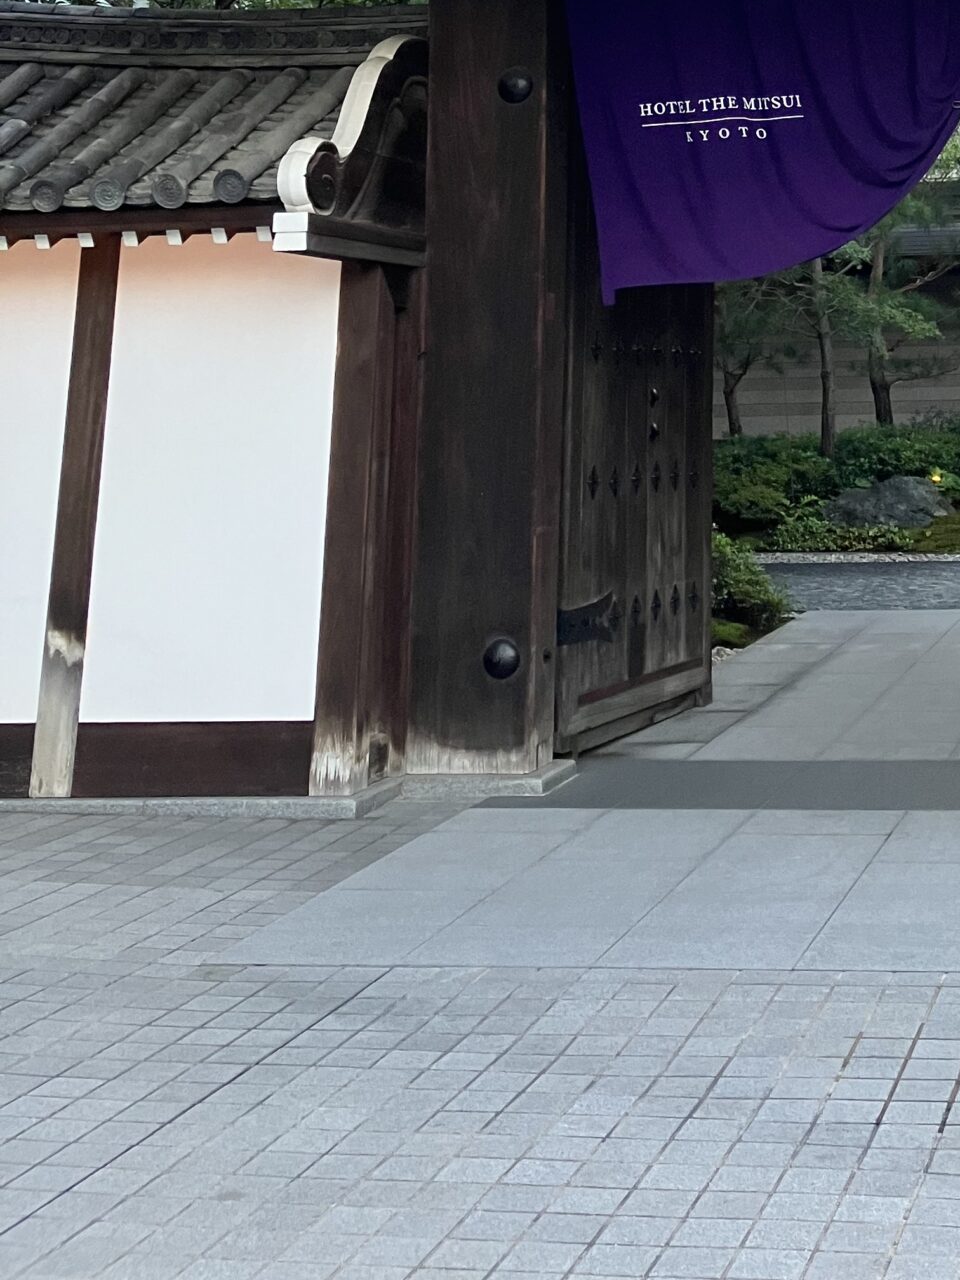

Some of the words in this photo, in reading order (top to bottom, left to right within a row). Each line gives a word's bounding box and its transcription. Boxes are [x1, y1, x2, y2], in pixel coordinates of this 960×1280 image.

[639, 100, 695, 116] HOTEL
[698, 96, 739, 112] THE
[742, 94, 802, 110] MITSUI
[686, 126, 767, 142] KYOTO
